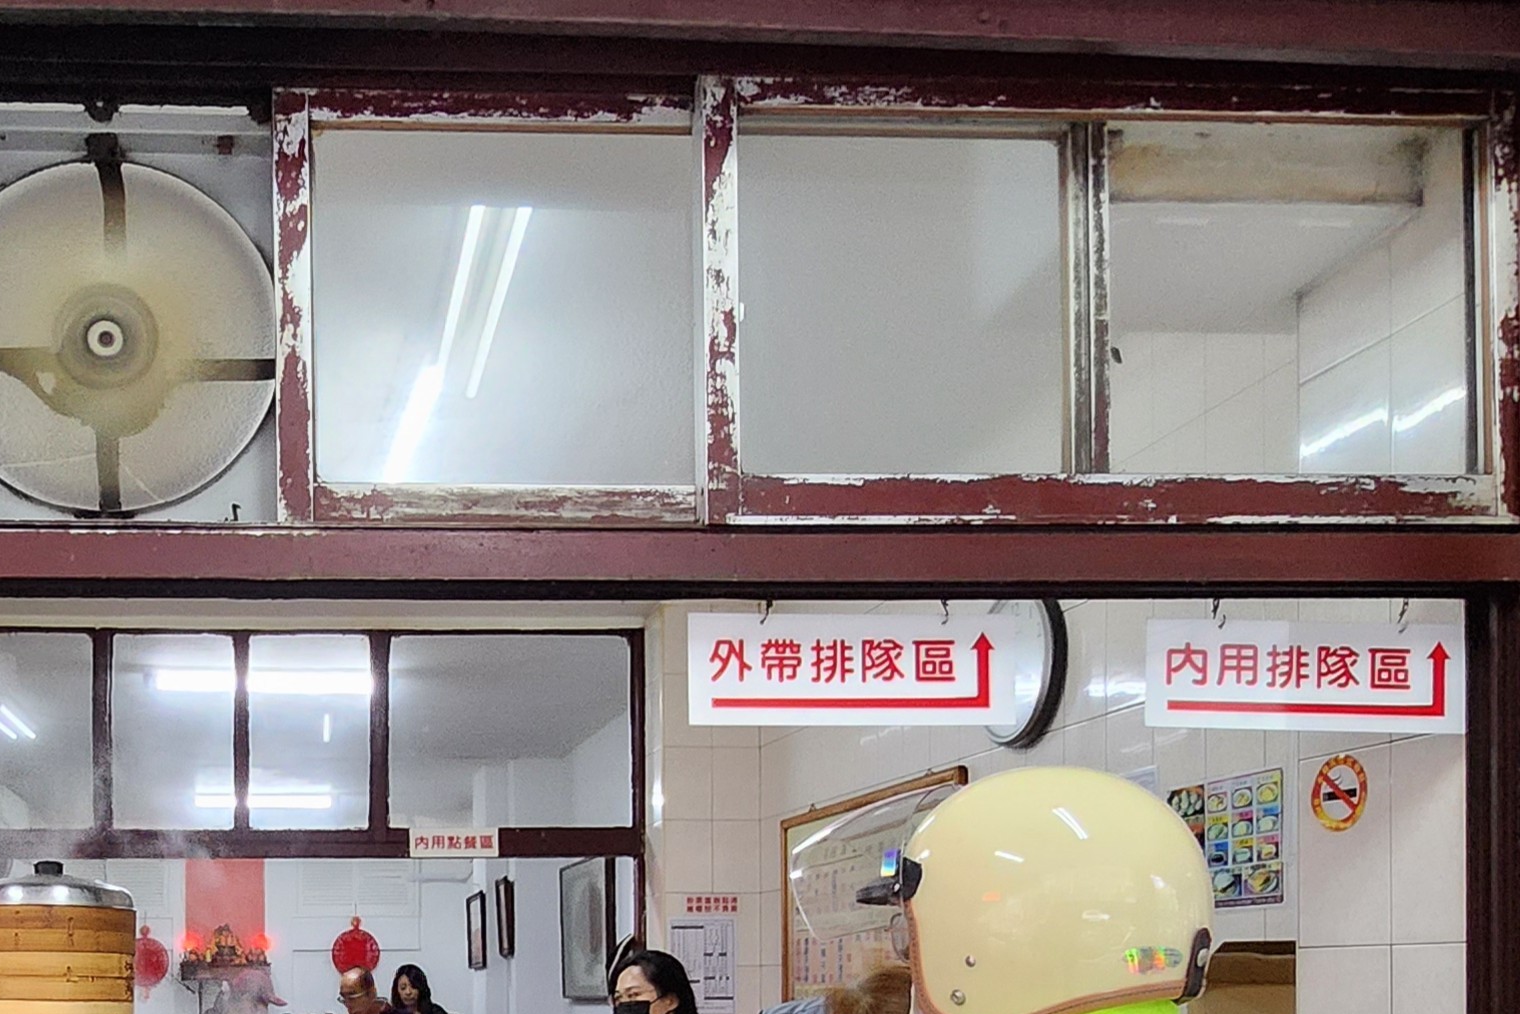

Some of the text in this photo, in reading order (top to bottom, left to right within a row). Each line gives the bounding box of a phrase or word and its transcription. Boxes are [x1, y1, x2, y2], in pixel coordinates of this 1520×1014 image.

[709, 638, 957, 685] 外帶排隊區
